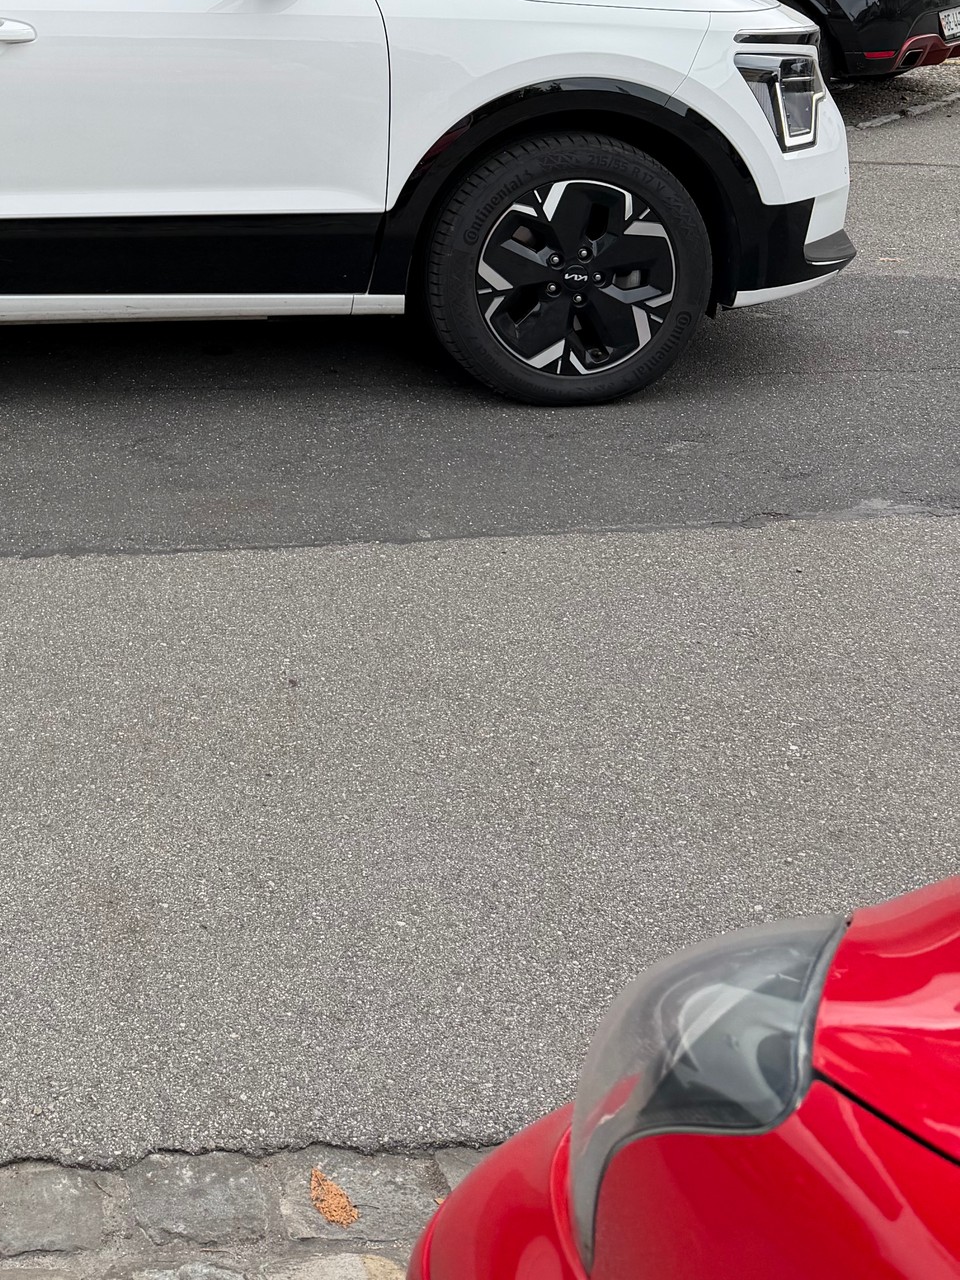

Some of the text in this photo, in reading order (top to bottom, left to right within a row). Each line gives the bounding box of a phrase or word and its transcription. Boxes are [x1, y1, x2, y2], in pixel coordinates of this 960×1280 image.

[588, 154, 628, 172] 215/55
[463, 174, 523, 245] Continental
[633, 311, 691, 381] Continental
